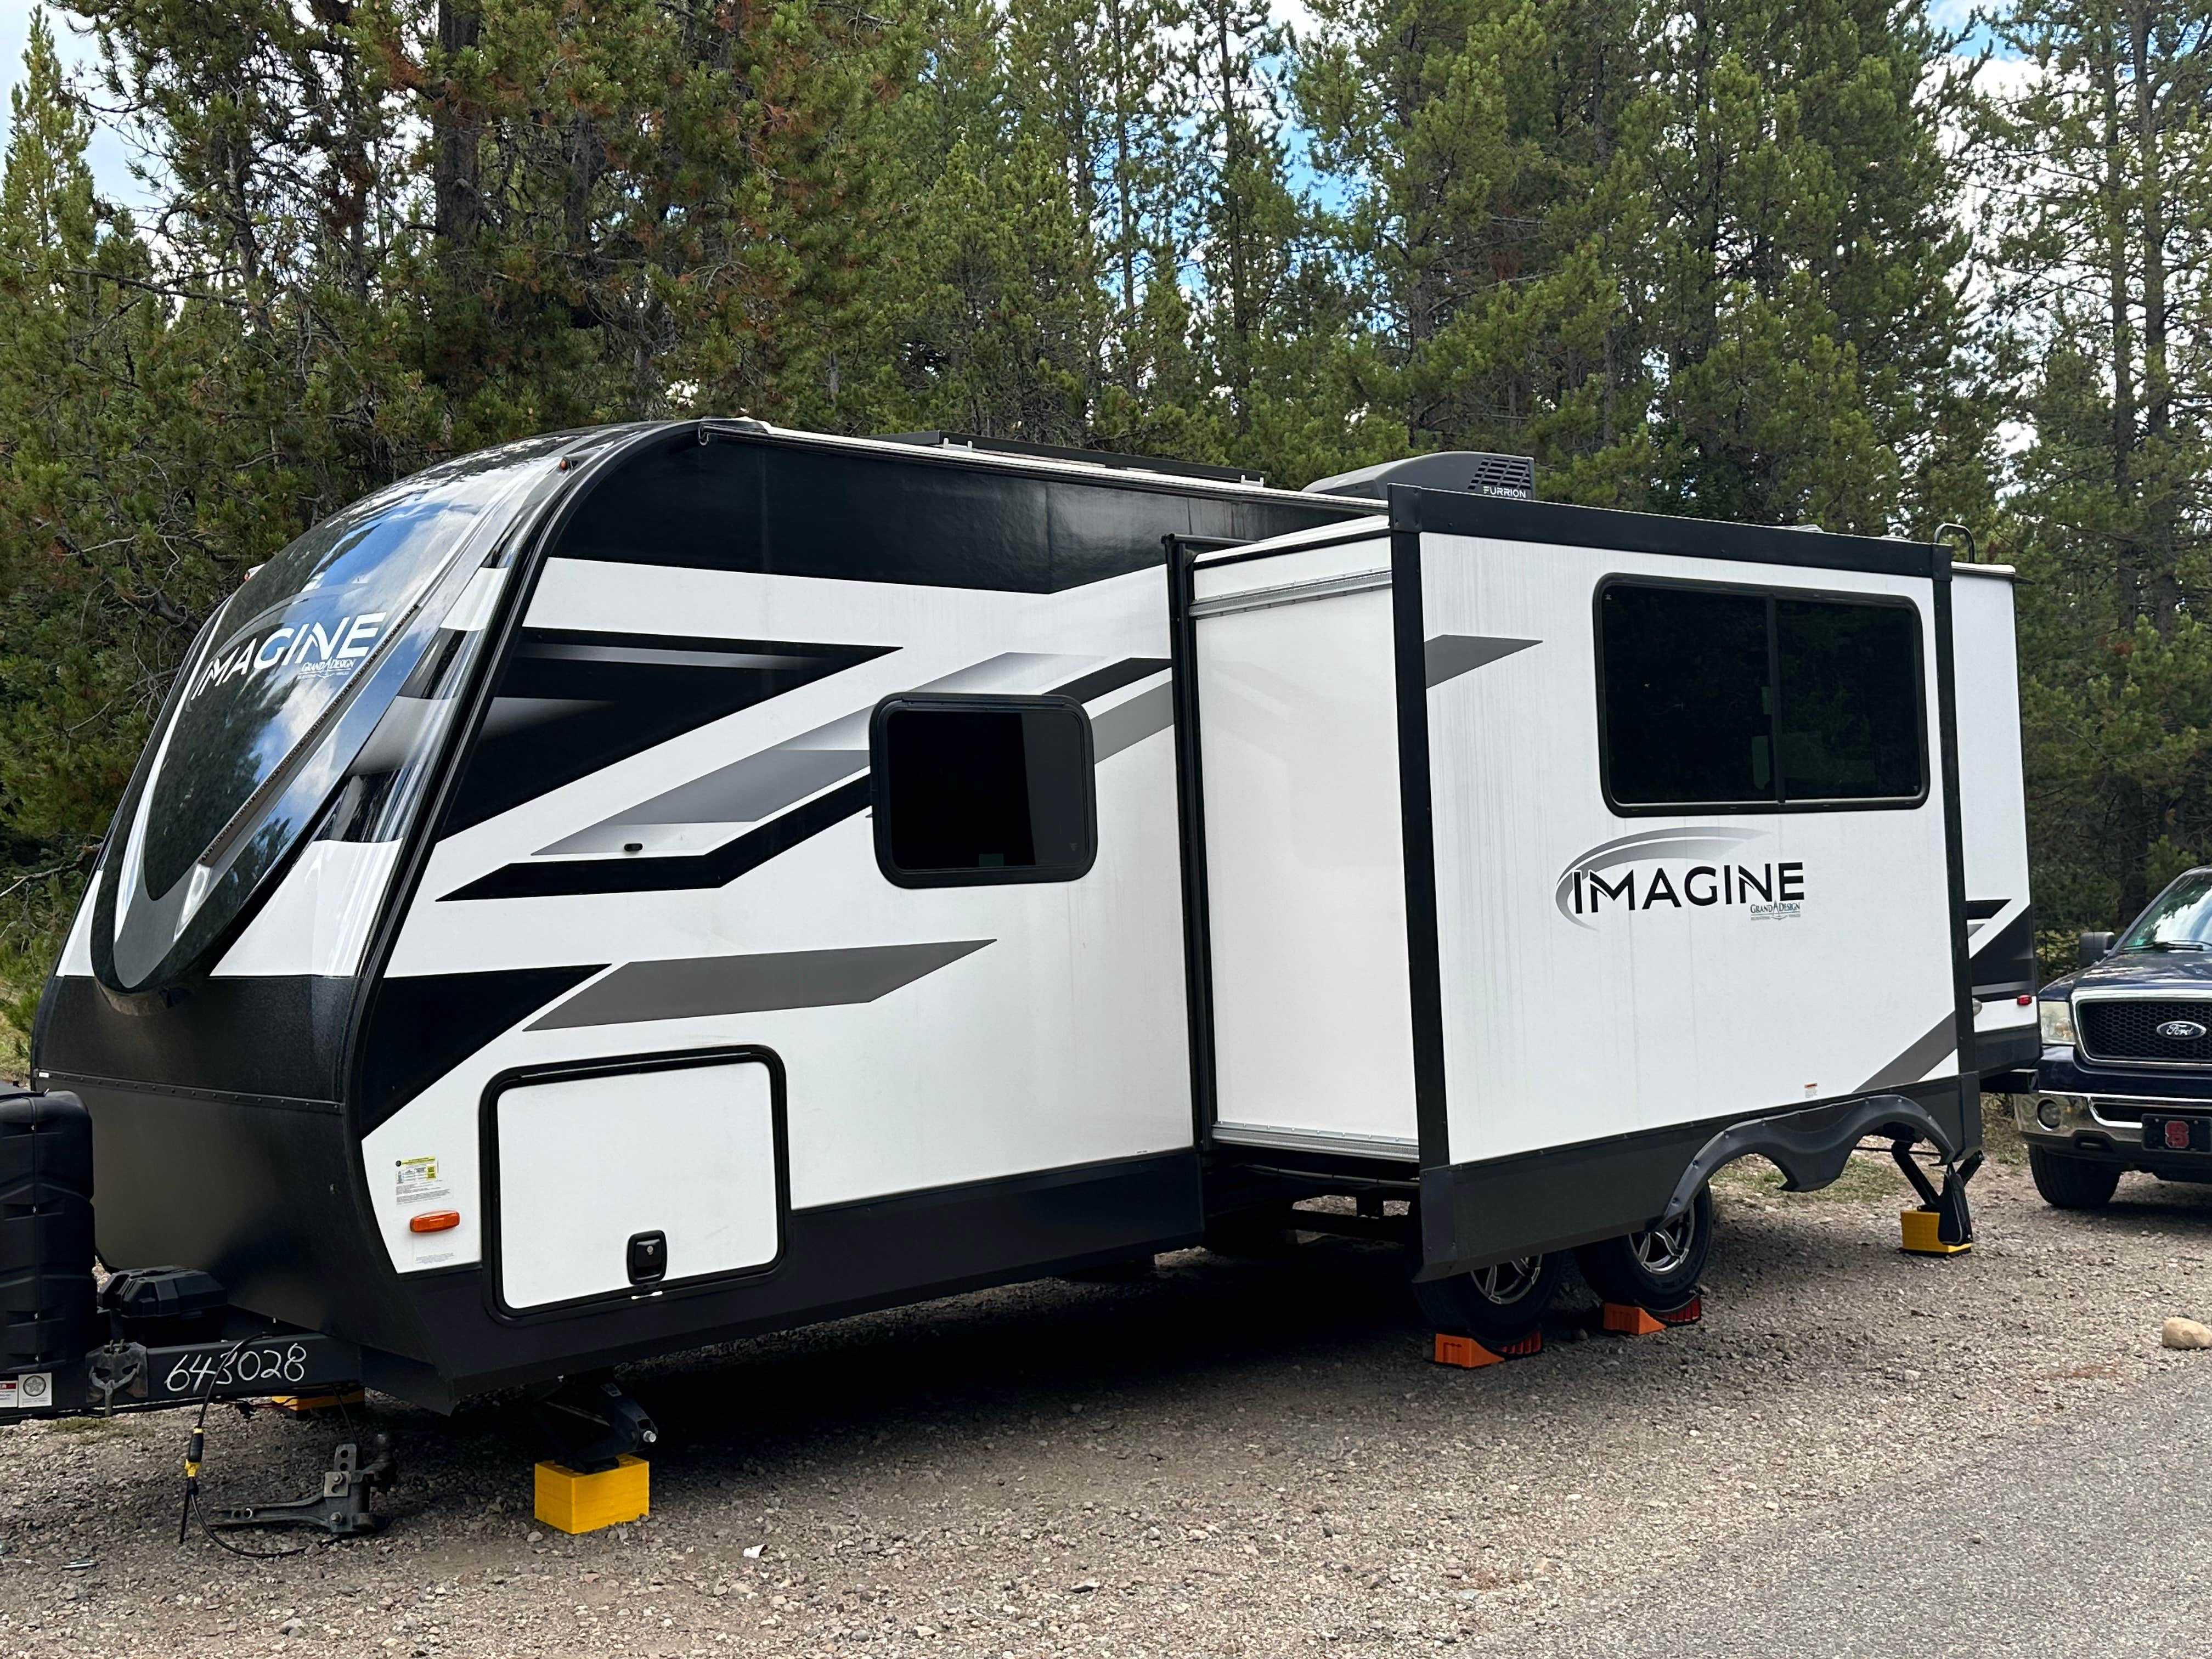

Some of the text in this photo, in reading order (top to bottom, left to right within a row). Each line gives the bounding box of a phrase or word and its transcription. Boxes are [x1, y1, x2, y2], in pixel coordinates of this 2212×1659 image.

[1483, 486, 1526, 498] FURRION
[191, 612, 386, 700] IMAGINE
[1573, 862, 1804, 914] IMAGINE
[2166, 1024, 2194, 1035] Ford
[164, 1342, 307, 1395] 643028
